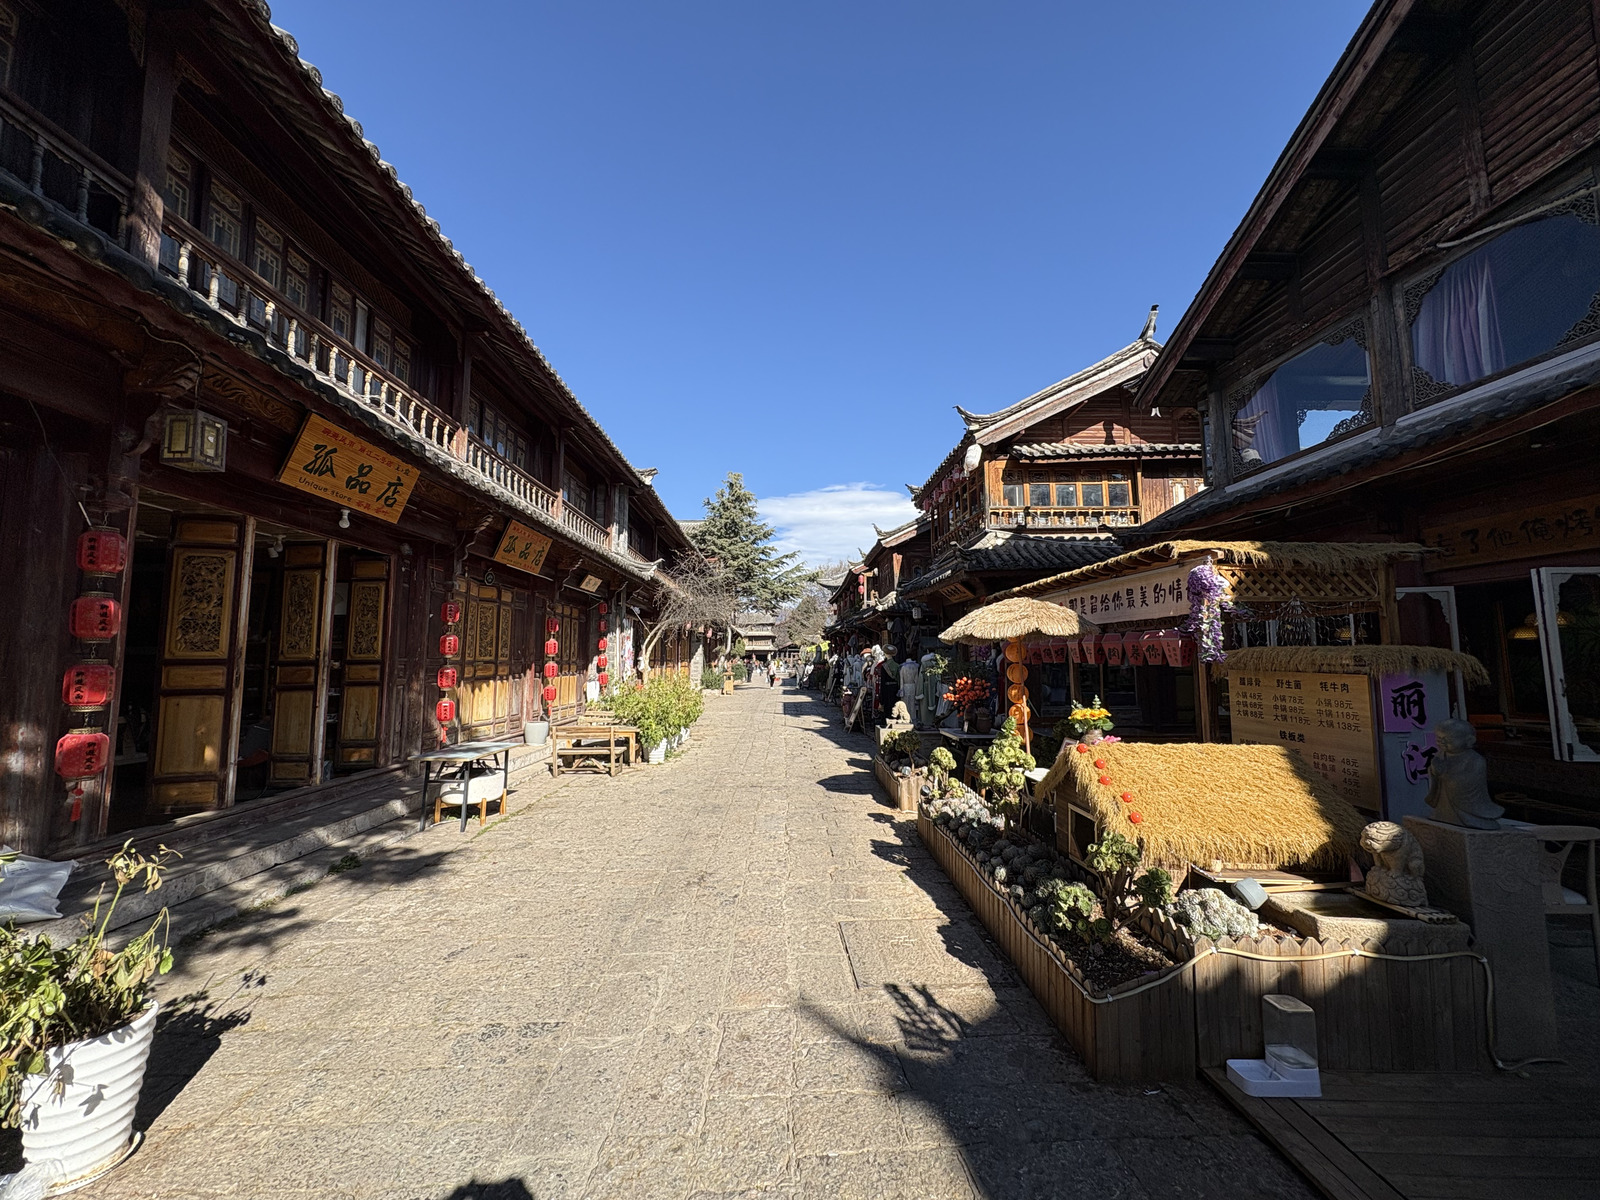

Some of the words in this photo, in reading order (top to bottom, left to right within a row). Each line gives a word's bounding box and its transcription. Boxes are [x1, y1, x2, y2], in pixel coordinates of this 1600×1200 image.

[303, 444, 404, 508] 孤品店
[298, 476, 328, 493] Unique
[330, 490, 352, 502] store
[1433, 505, 1600, 559] 忘了他俺烤
[503, 535, 545, 567] 孤品店
[1068, 578, 1189, 616] 那是留给你最美的情
[1276, 679, 1302, 690] 野生菌
[1235, 691, 1248, 699] 小锅
[1249, 692, 1263, 701] 48元
[1272, 694, 1287, 703] 小锅
[1288, 695, 1305, 705] 78元
[1236, 700, 1248, 709] 中锅
[1249, 701, 1263, 710] 68元
[1273, 703, 1287, 713] 中锅
[1288, 705, 1306, 715] 98元
[1315, 698, 1332, 708] 小锅
[1334, 700, 1354, 710] 98元
[1236, 709, 1249, 718] 大锅
[1250, 710, 1264, 719] 88元
[1273, 713, 1288, 722] 大锅
[1289, 715, 1311, 726] 118元
[1316, 708, 1333, 718] 中锅
[1335, 710, 1360, 721] 118元
[1317, 719, 1334, 728] 大锅
[1337, 721, 1361, 732] 138元
[1391, 681, 1438, 781] 丽江
[1279, 730, 1305, 743] 铁板类
[1341, 758, 1359, 768] 48元
[1341, 767, 1360, 778] 45元
[1342, 777, 1361, 788] 45元
[1343, 787, 1361, 798] 30元
